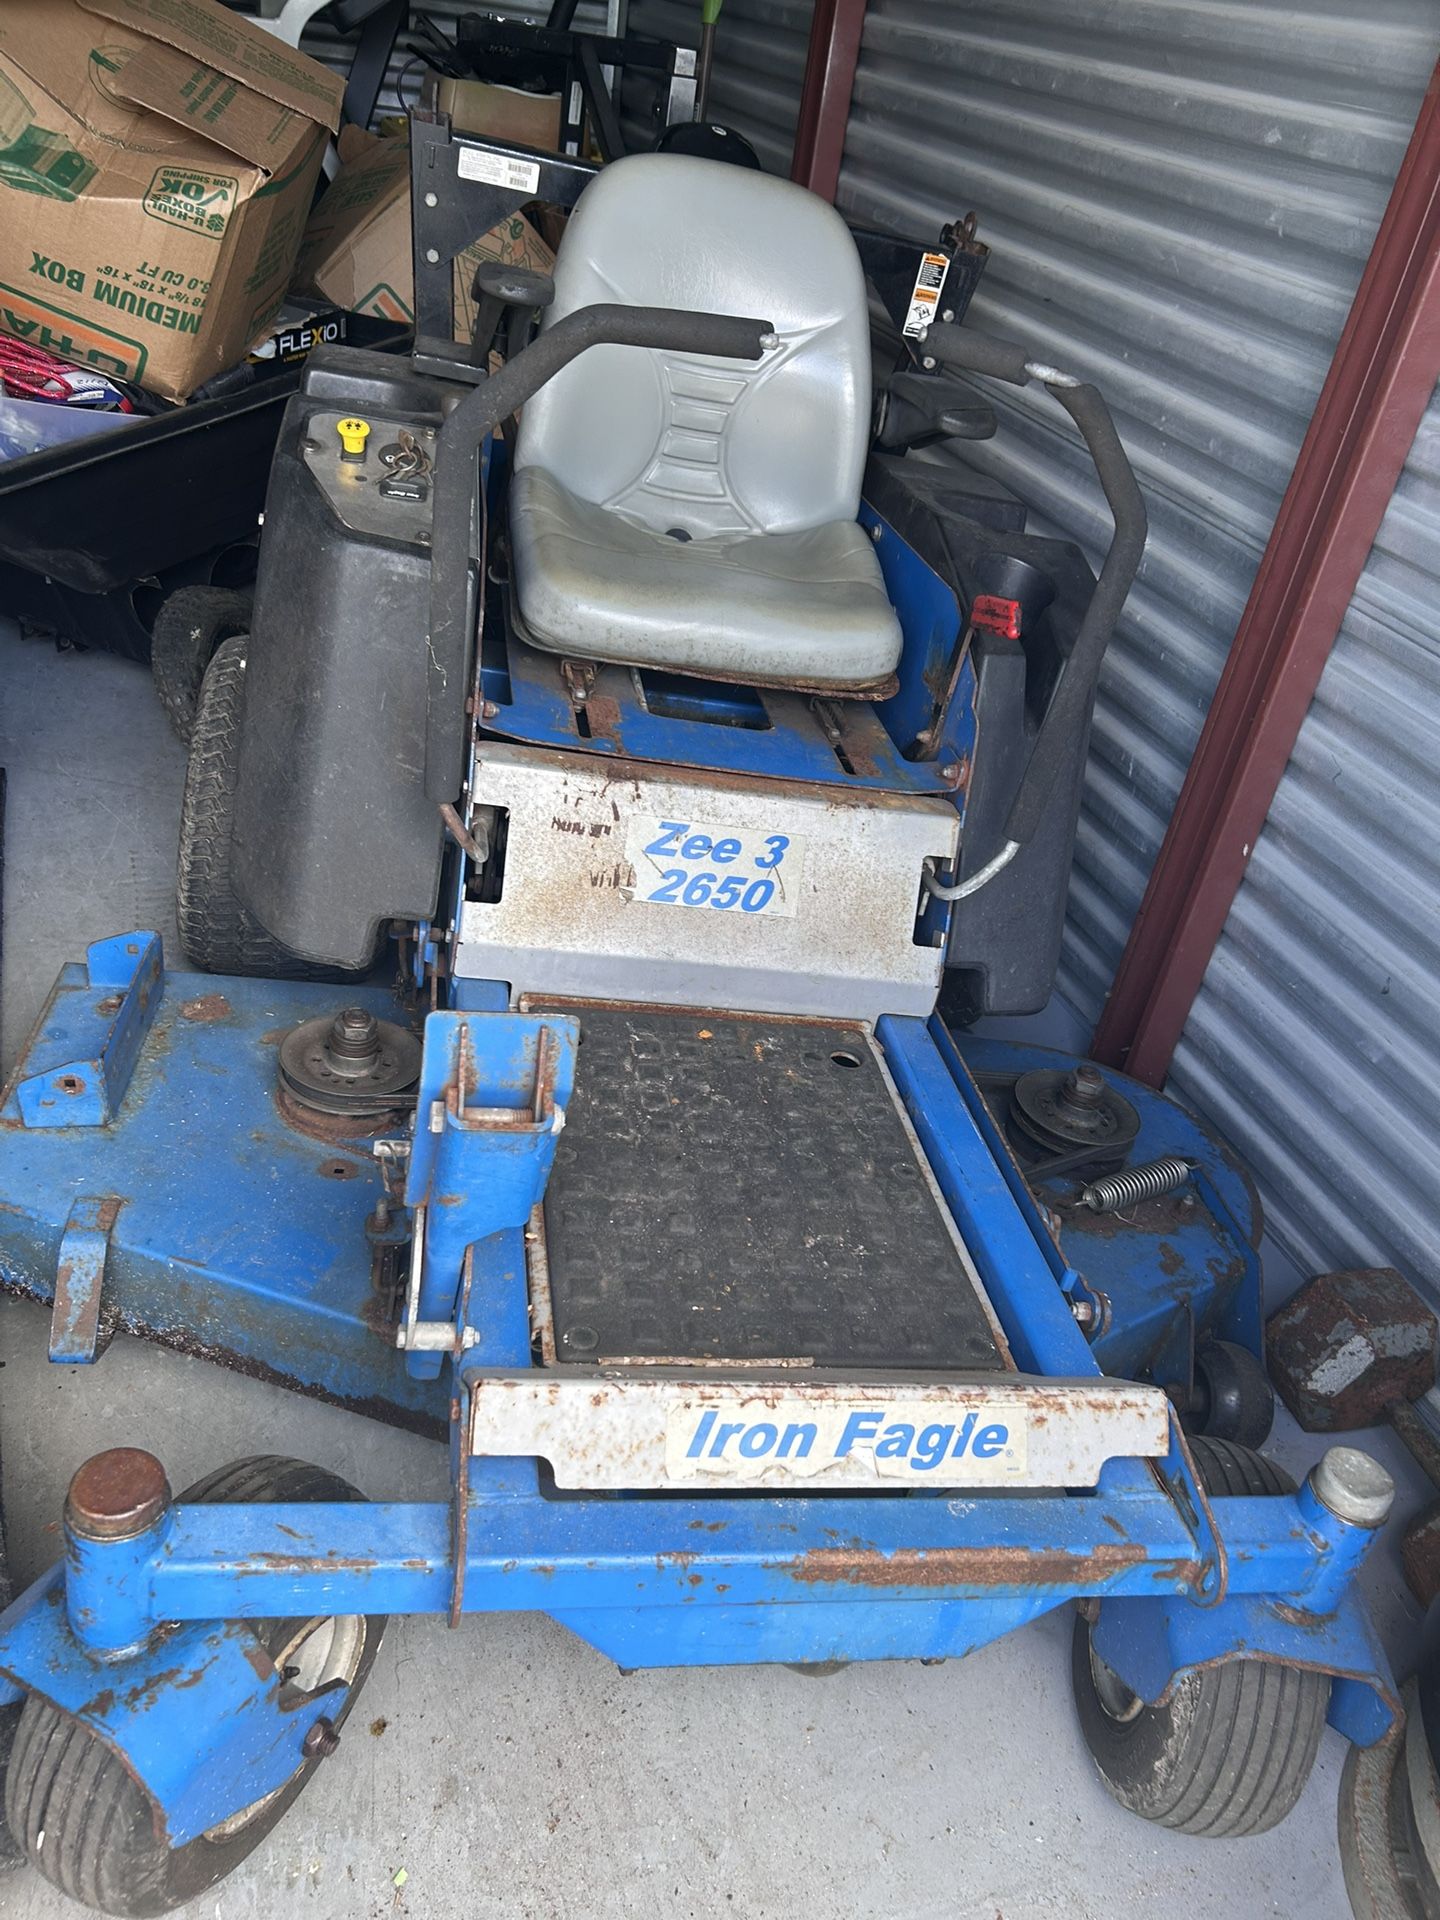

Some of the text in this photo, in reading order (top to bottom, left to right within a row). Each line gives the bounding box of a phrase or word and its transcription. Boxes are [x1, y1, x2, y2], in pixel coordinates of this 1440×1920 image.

[157, 178, 205, 201] OK
[162, 170, 233, 189] FOR SHIPPING
[150, 193, 207, 218] BOXES
[151, 200, 205, 227] U-HAUL
[28, 250, 86, 293] BOX
[95, 265, 119, 279] 16"
[121, 271, 133, 282] x
[136, 261, 212, 294] 3.0 CU FT
[132, 279, 155, 293] 18"
[156, 285, 168, 296] x
[93, 279, 203, 335] MEDIUM
[0, 307, 129, 376] U-HA
[644, 821, 791, 869] Zee 3
[647, 868, 776, 913] 2650
[686, 1410, 818, 1459] Iron
